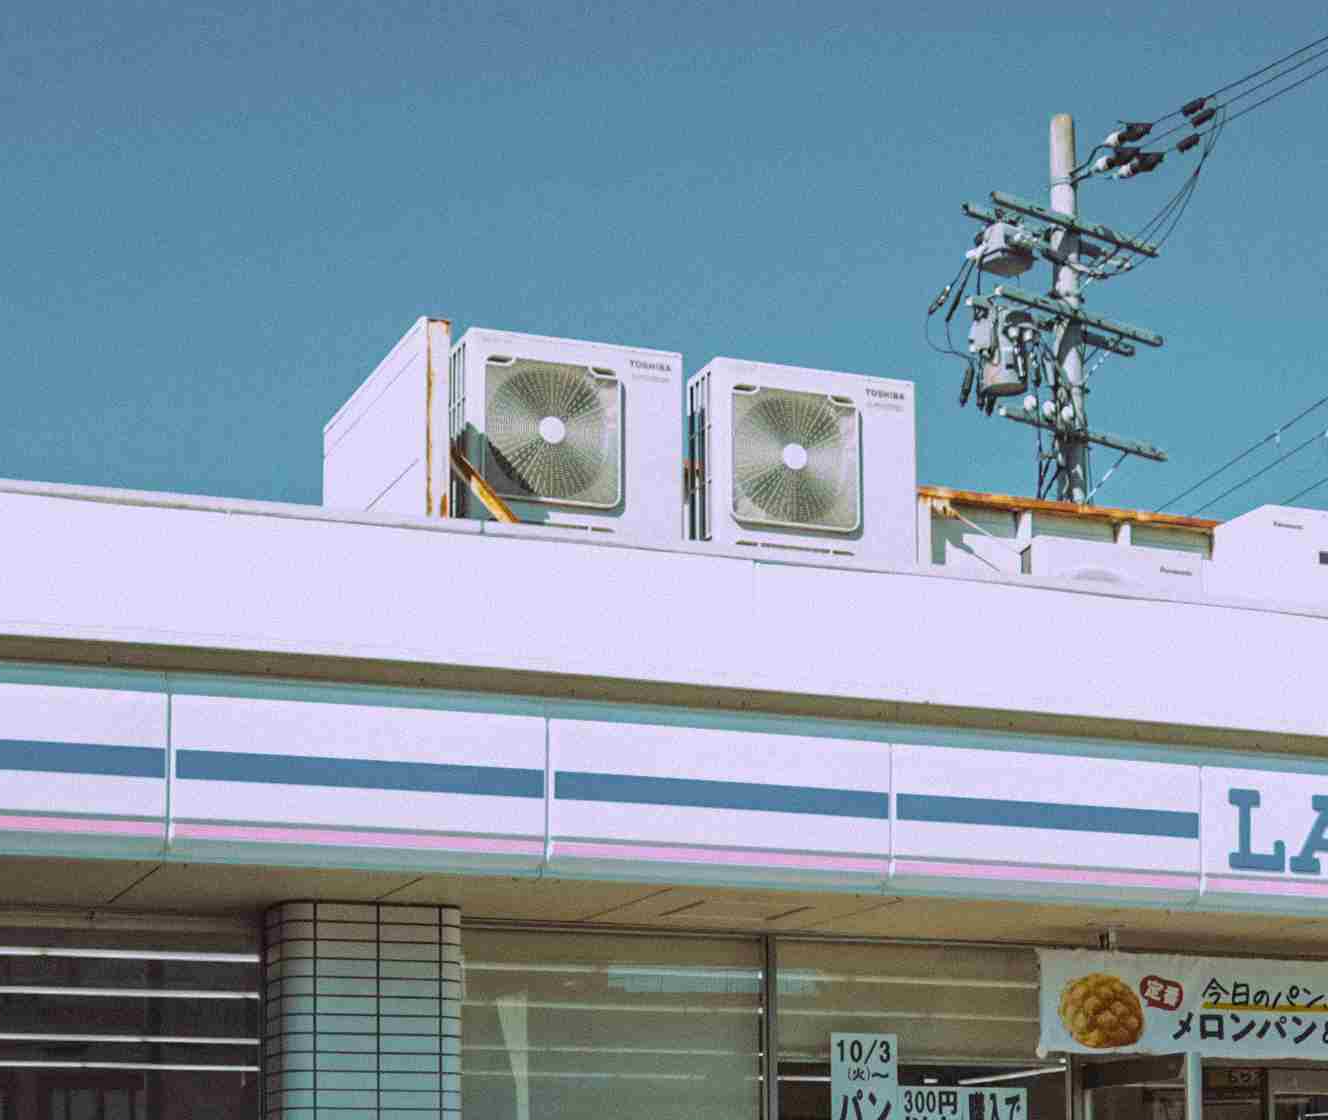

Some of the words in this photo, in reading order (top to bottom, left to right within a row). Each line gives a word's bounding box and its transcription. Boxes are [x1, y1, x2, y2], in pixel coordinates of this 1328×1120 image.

[630, 359, 672, 372] TOSHIBA
[865, 388, 905, 400] TOSHIBA
[836, 1039, 891, 1065] 10/3
